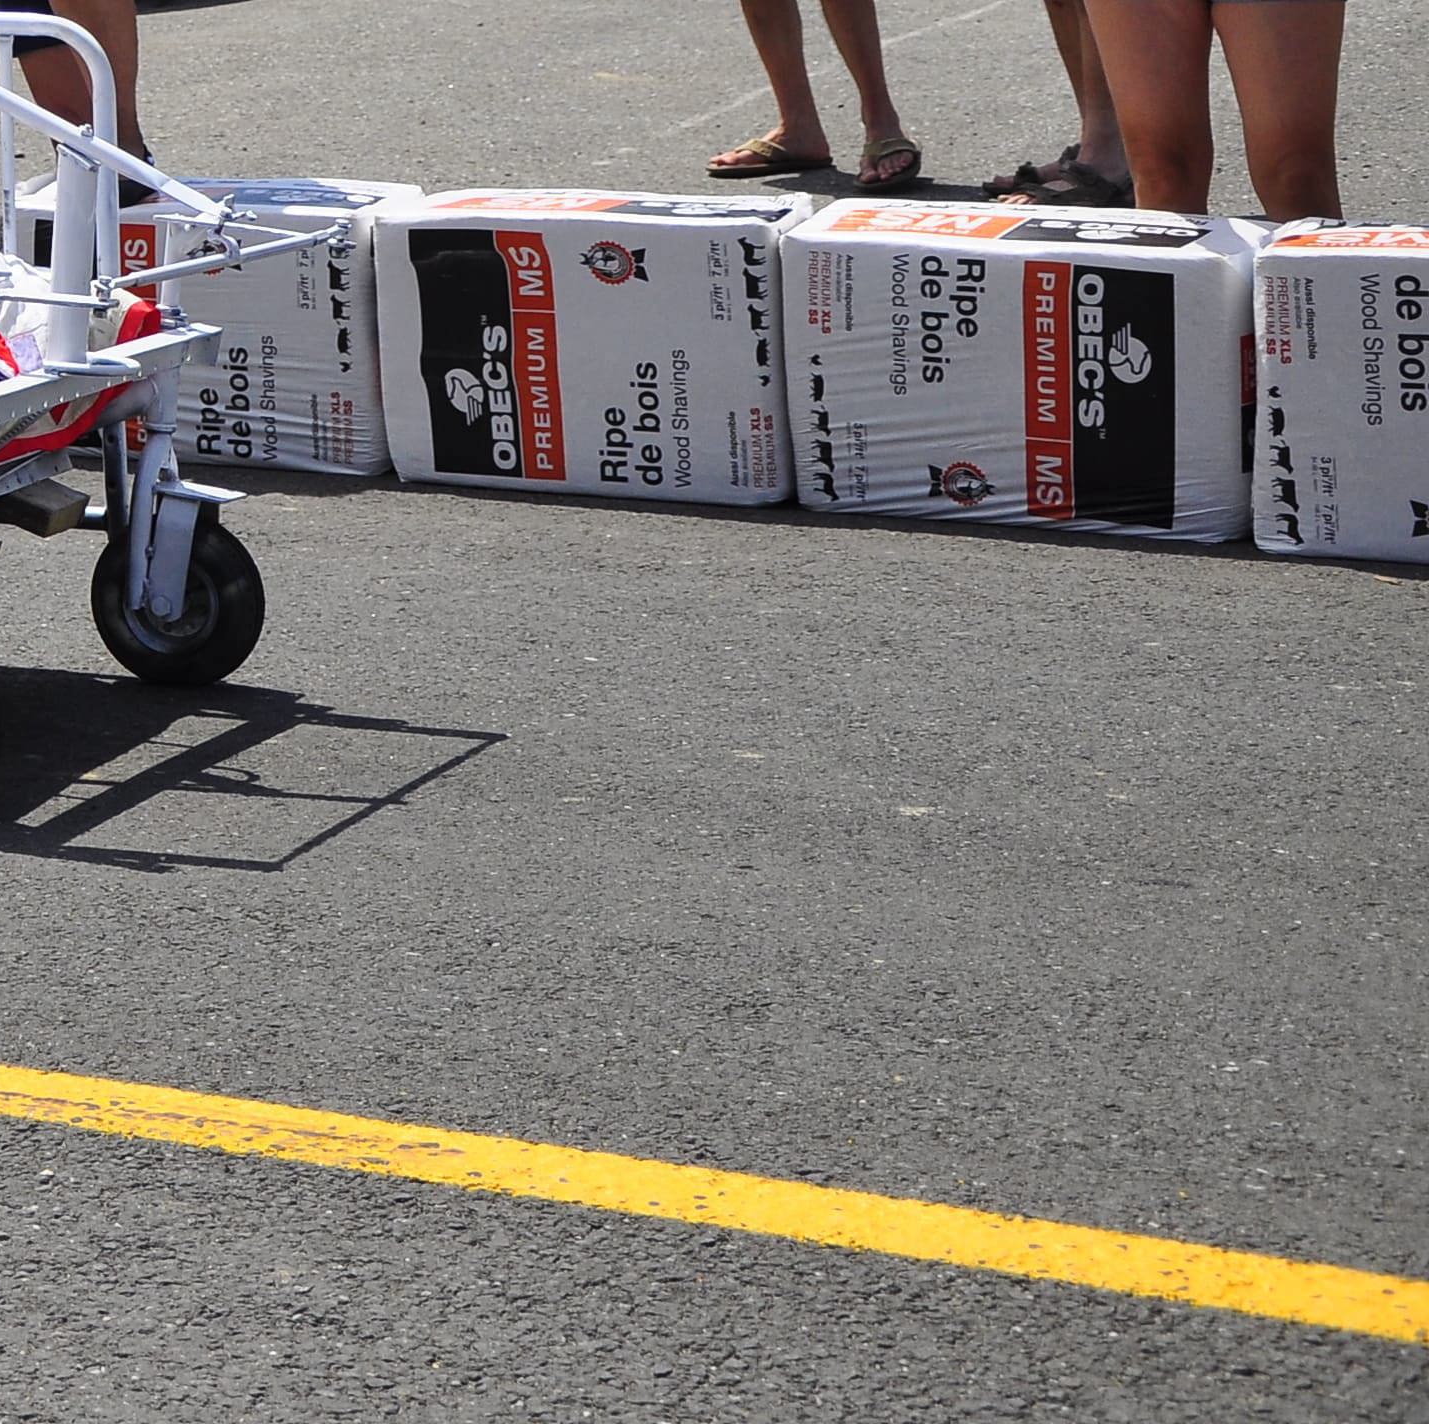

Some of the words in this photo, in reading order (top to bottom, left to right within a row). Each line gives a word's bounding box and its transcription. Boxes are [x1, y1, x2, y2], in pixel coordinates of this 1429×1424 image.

[508, 247, 545, 296] MS
[808, 251, 818, 306] PREMIUM
[821, 252, 831, 308] PREMIUM
[845, 255, 855, 282] Aussi
[892, 254, 909, 307] Wood
[921, 256, 949, 298] de
[1304, 278, 1315, 305] Aussi
[808, 309, 818, 325] SS
[821, 310, 831, 334] XLS
[843, 283, 854, 332] disponible
[950, 259, 985, 337] Ripe
[1277, 277, 1290, 336] PREMIUM
[1360, 274, 1383, 330] Wood
[1395, 275, 1429, 320] de
[890, 313, 910, 395] Shavings
[921, 312, 950, 383] bois
[1036, 272, 1056, 423] PREMIUM
[1077, 273, 1104, 427] OBEC'S
[1266, 339, 1276, 354] SS
[1280, 339, 1292, 364] XLS
[1304, 308, 1317, 360] disponible
[223, 347, 250, 412] bois
[259, 336, 278, 410] Shavings
[481, 325, 517, 469] OBEC'S
[527, 328, 553, 470] PREMIUM
[630, 362, 660, 432] bois
[669, 349, 690, 430] Shavings
[1361, 337, 1385, 426] Shavings
[1398, 334, 1429, 412] bois
[196, 388, 225, 455] Ripe
[228, 420, 252, 458] de
[260, 416, 277, 461] Wood
[599, 407, 633, 483] Ripe
[727, 411, 739, 460] disponible
[749, 407, 761, 431] XLS
[764, 415, 774, 431] SS
[635, 444, 663, 486] de
[673, 436, 691, 487] Wood
[728, 461, 739, 487] Aussi
[752, 433, 764, 488] PREMIUM
[766, 432, 777, 488] PREMIUM
[1035, 455, 1063, 505] MS
